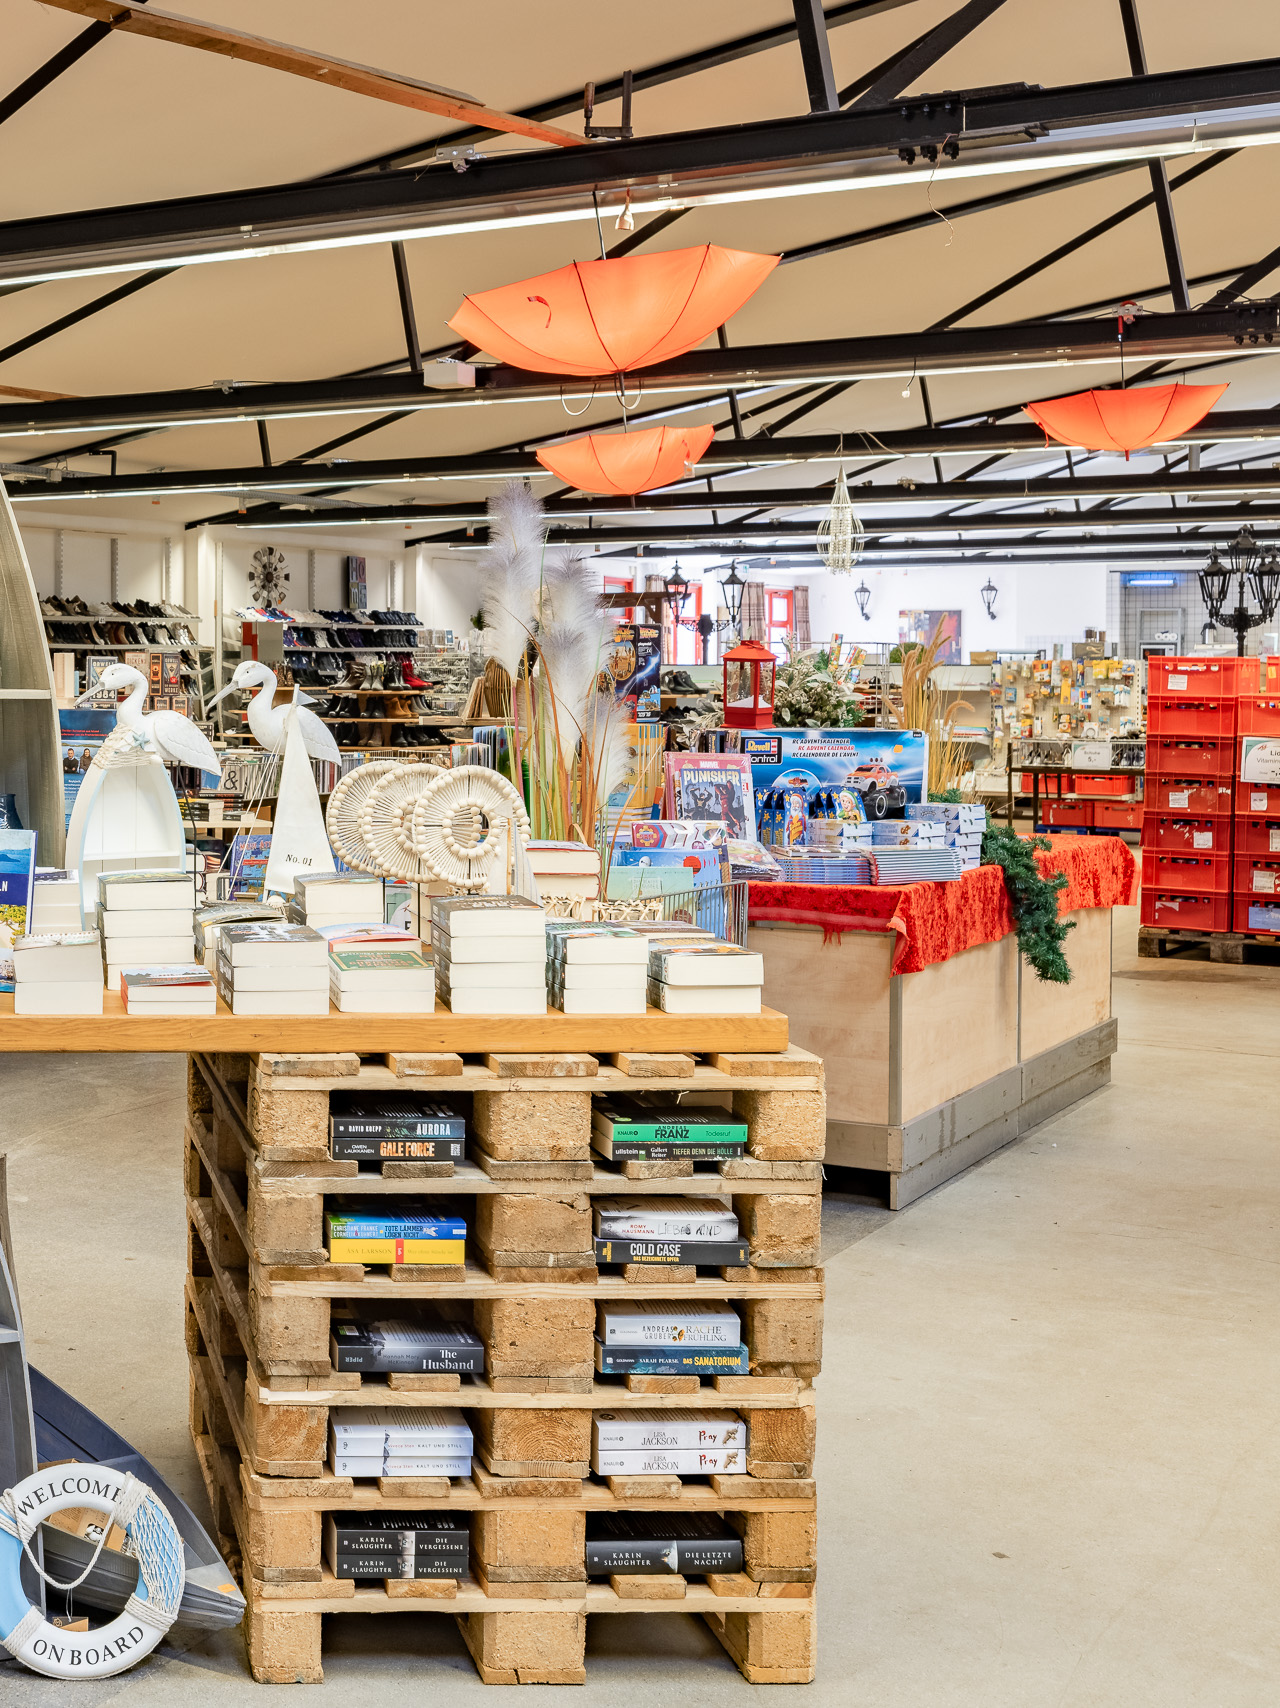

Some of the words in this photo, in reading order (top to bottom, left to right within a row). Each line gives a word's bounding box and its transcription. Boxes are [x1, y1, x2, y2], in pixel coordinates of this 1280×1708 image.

[748, 741, 770, 751] Revell
[750, 755, 777, 763] ontrol
[224, 770, 238, 790] &
[683, 771, 740, 786] PUNISHER
[286, 854, 300, 863] No.
[303, 858, 312, 866] 01
[416, 1124, 450, 1136] AURORA
[654, 1130, 689, 1138] FRANZ
[380, 1142, 404, 1156] GALE
[406, 1142, 435, 1156] FORCE
[630, 1244, 654, 1256] COLD
[657, 1244, 680, 1256] CASE
[686, 1326, 721, 1334] RACHE
[440, 1350, 457, 1358] The
[422, 1360, 474, 1370] Husband
[694, 1357, 741, 1366] SANATORIUM
[641, 1437, 678, 1445] JACKSON
[699, 1430, 717, 1445] Pray
[642, 1462, 679, 1470] JACKSON
[699, 1454, 718, 1470] Pray
[33, 1639, 65, 1663] ON
[69, 1626, 144, 1665] BOARD
